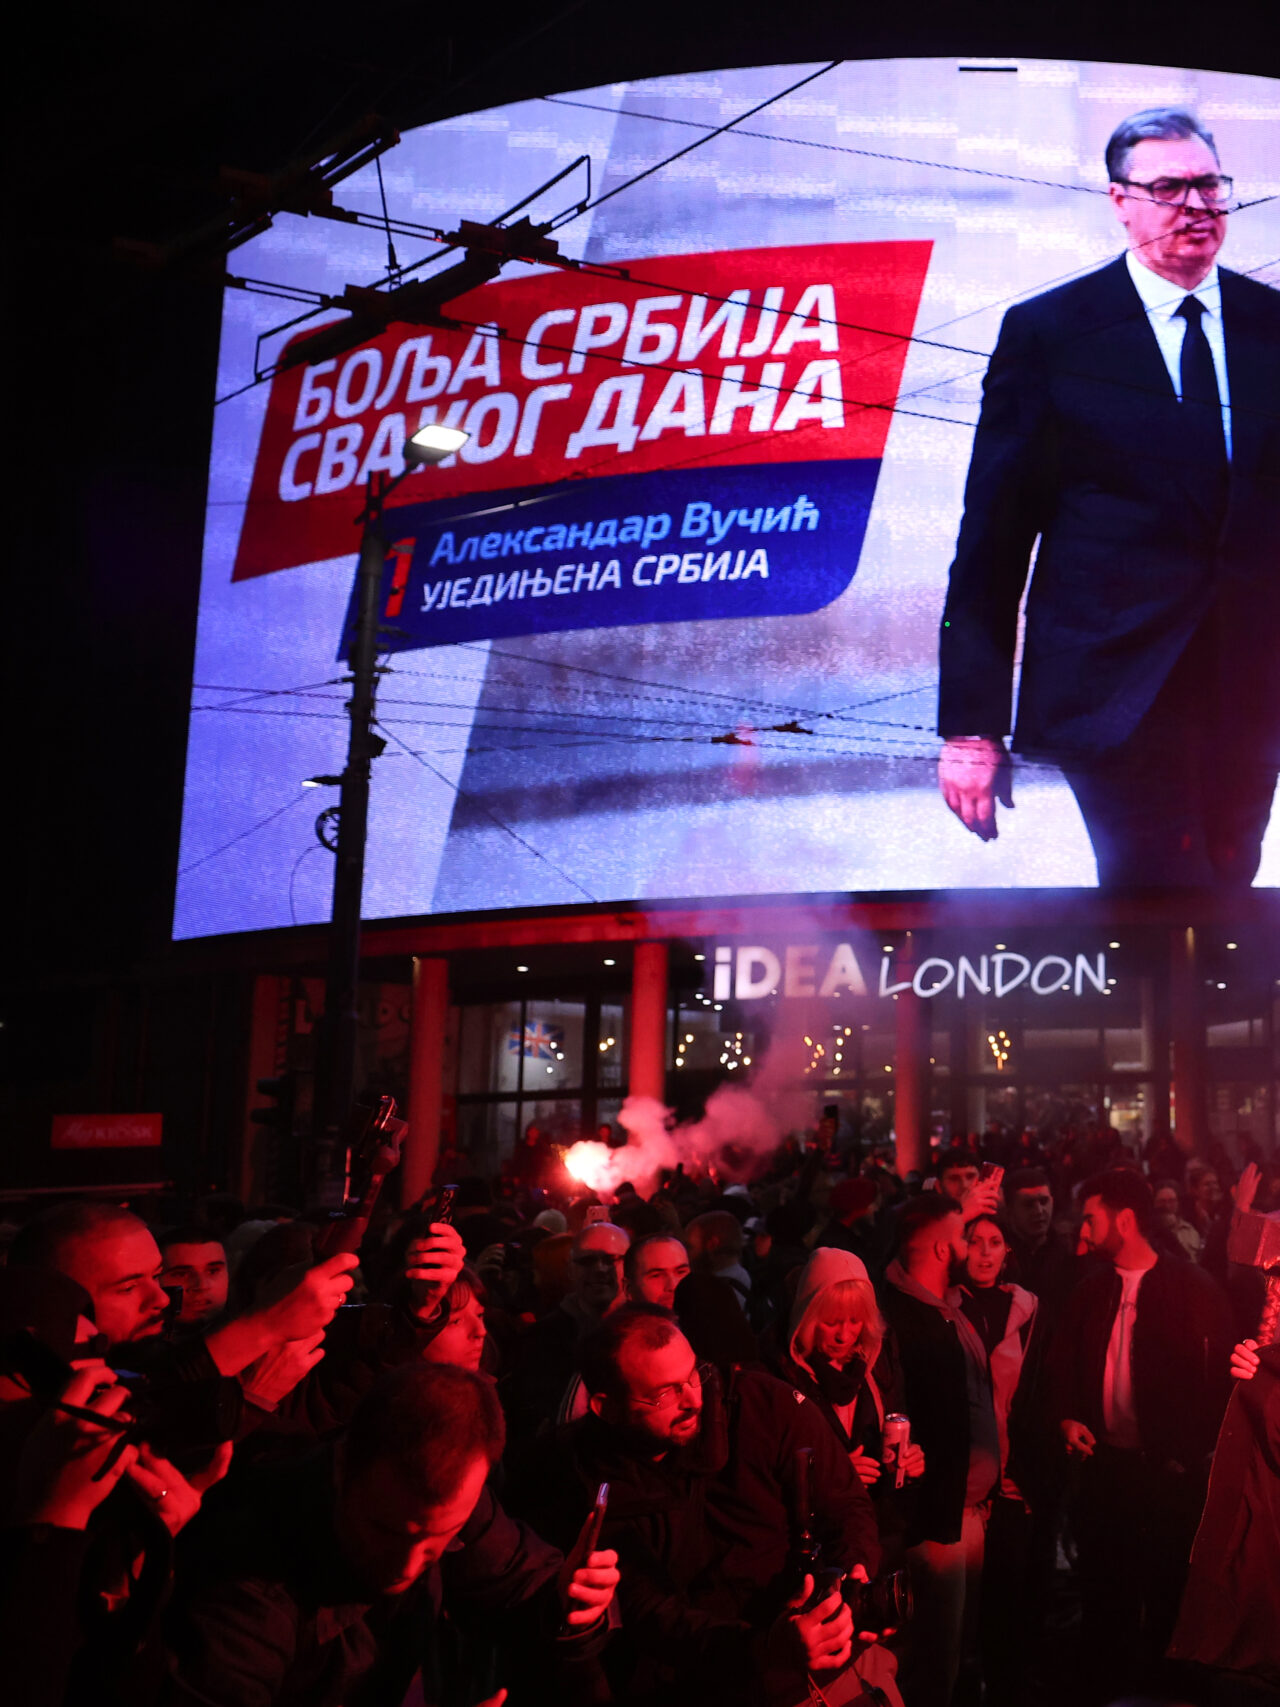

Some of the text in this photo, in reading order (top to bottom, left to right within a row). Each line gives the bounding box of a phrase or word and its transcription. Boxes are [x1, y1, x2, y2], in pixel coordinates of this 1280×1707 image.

[293, 284, 840, 431] БОЉА СРБИЈА
[564, 359, 845, 459] ДАНА
[428, 494, 820, 568] Александар Вучић
[420, 549, 769, 612] УЈЕДИЊЕНА СРБИЈА
[879, 953, 1106, 998] LONDON
